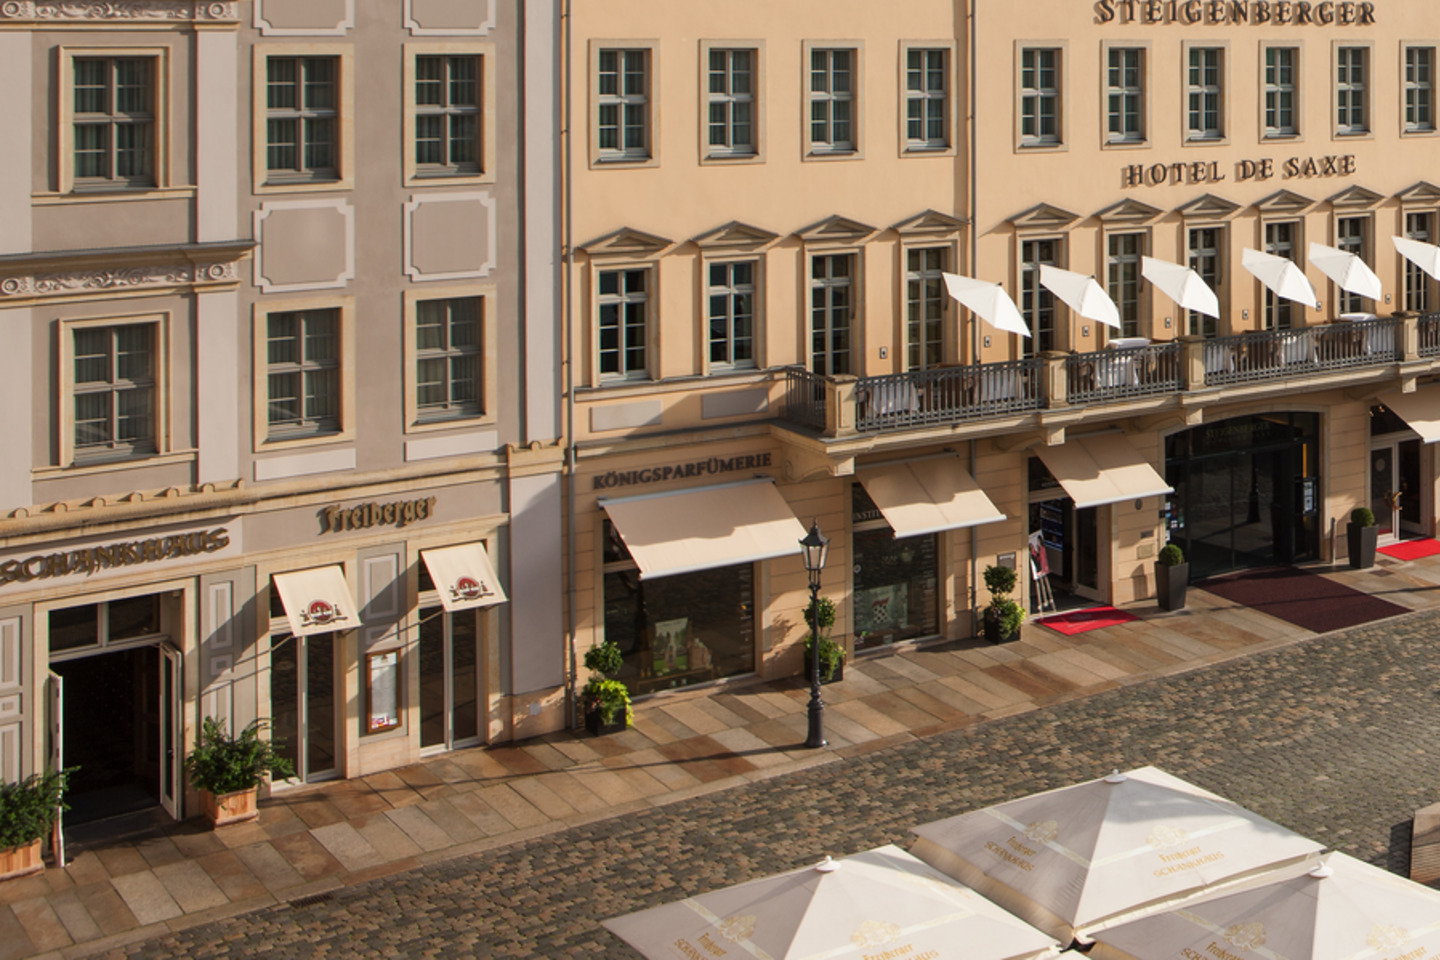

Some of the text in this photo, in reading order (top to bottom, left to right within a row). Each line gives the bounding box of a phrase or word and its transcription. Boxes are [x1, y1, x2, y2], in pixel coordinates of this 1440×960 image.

[1126, 154, 1357, 186] HOTEL DE SAXE
[593, 453, 772, 489] KÖNIGSPARFÜMERIE
[318, 496, 437, 534] Freiberger
